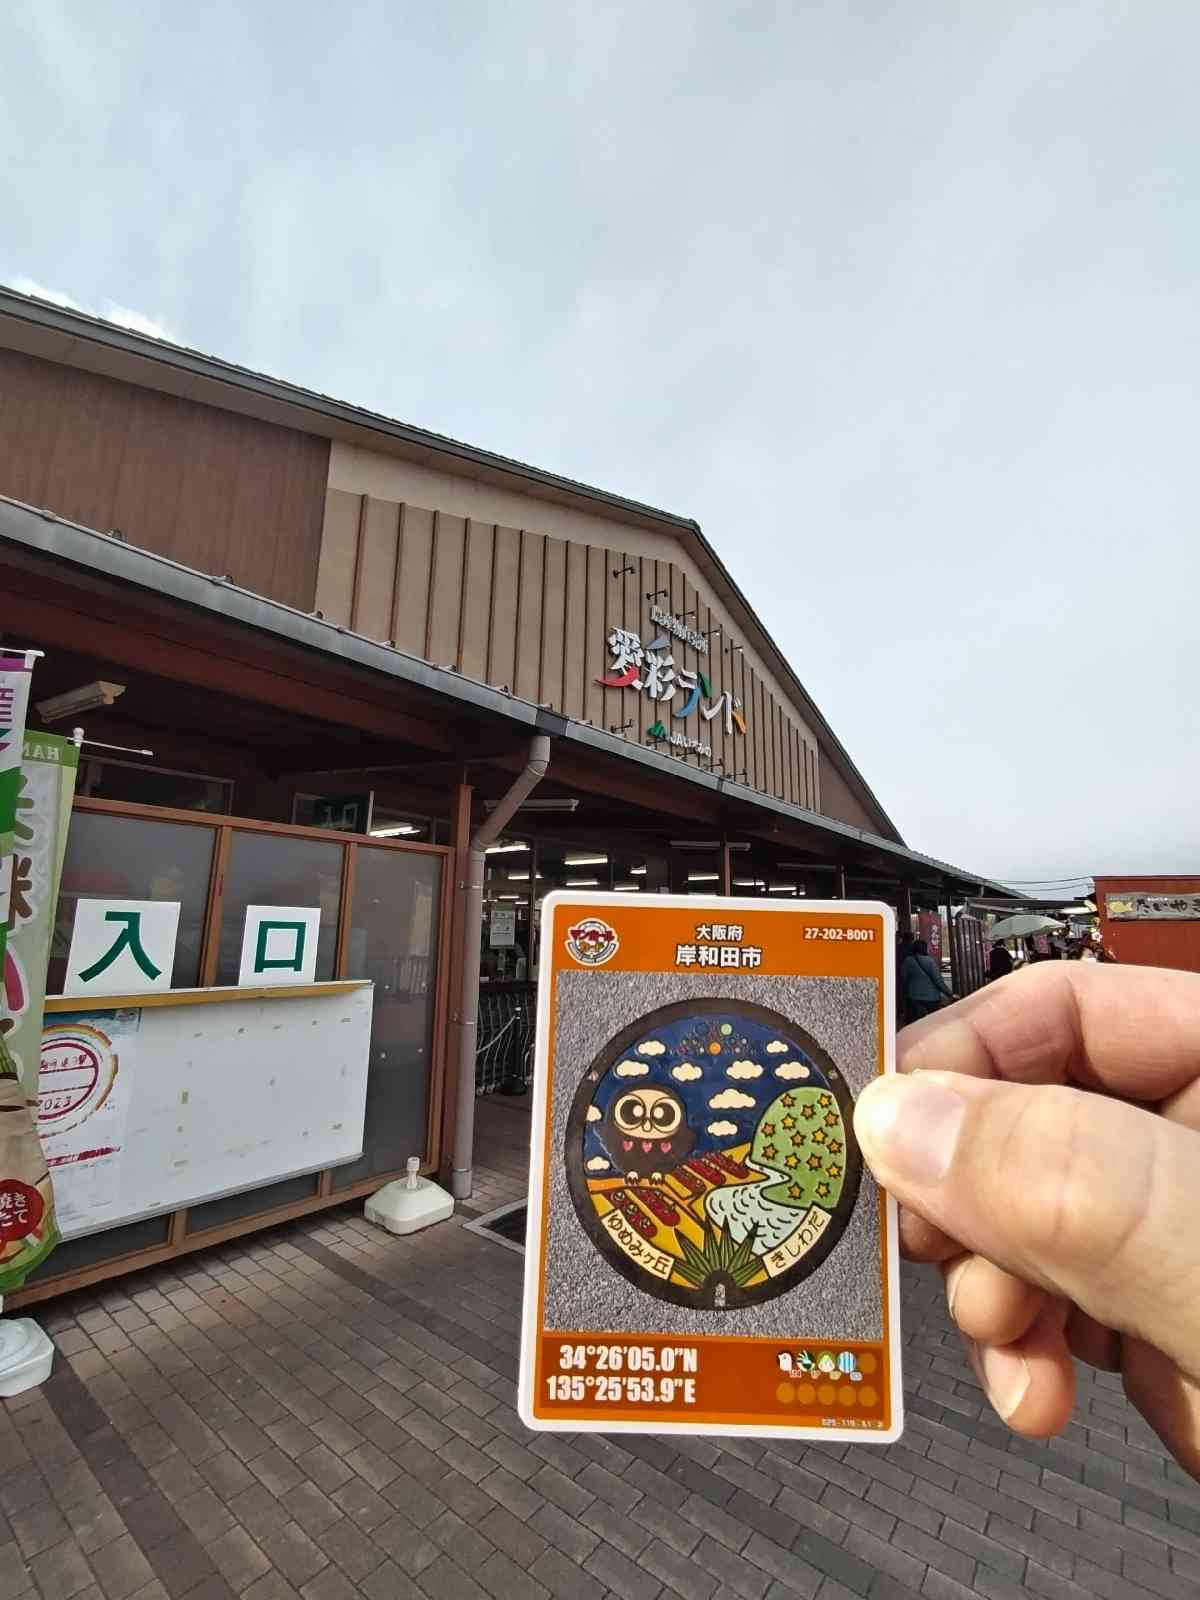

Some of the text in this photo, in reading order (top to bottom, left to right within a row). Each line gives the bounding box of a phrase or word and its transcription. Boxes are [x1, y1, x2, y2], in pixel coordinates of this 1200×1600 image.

[596, 626, 747, 736] 愛彩ランド
[696, 925, 743, 941] 大阪府
[675, 945, 762, 968] 岸和田市
[771, 1210, 826, 1269] きしわだ
